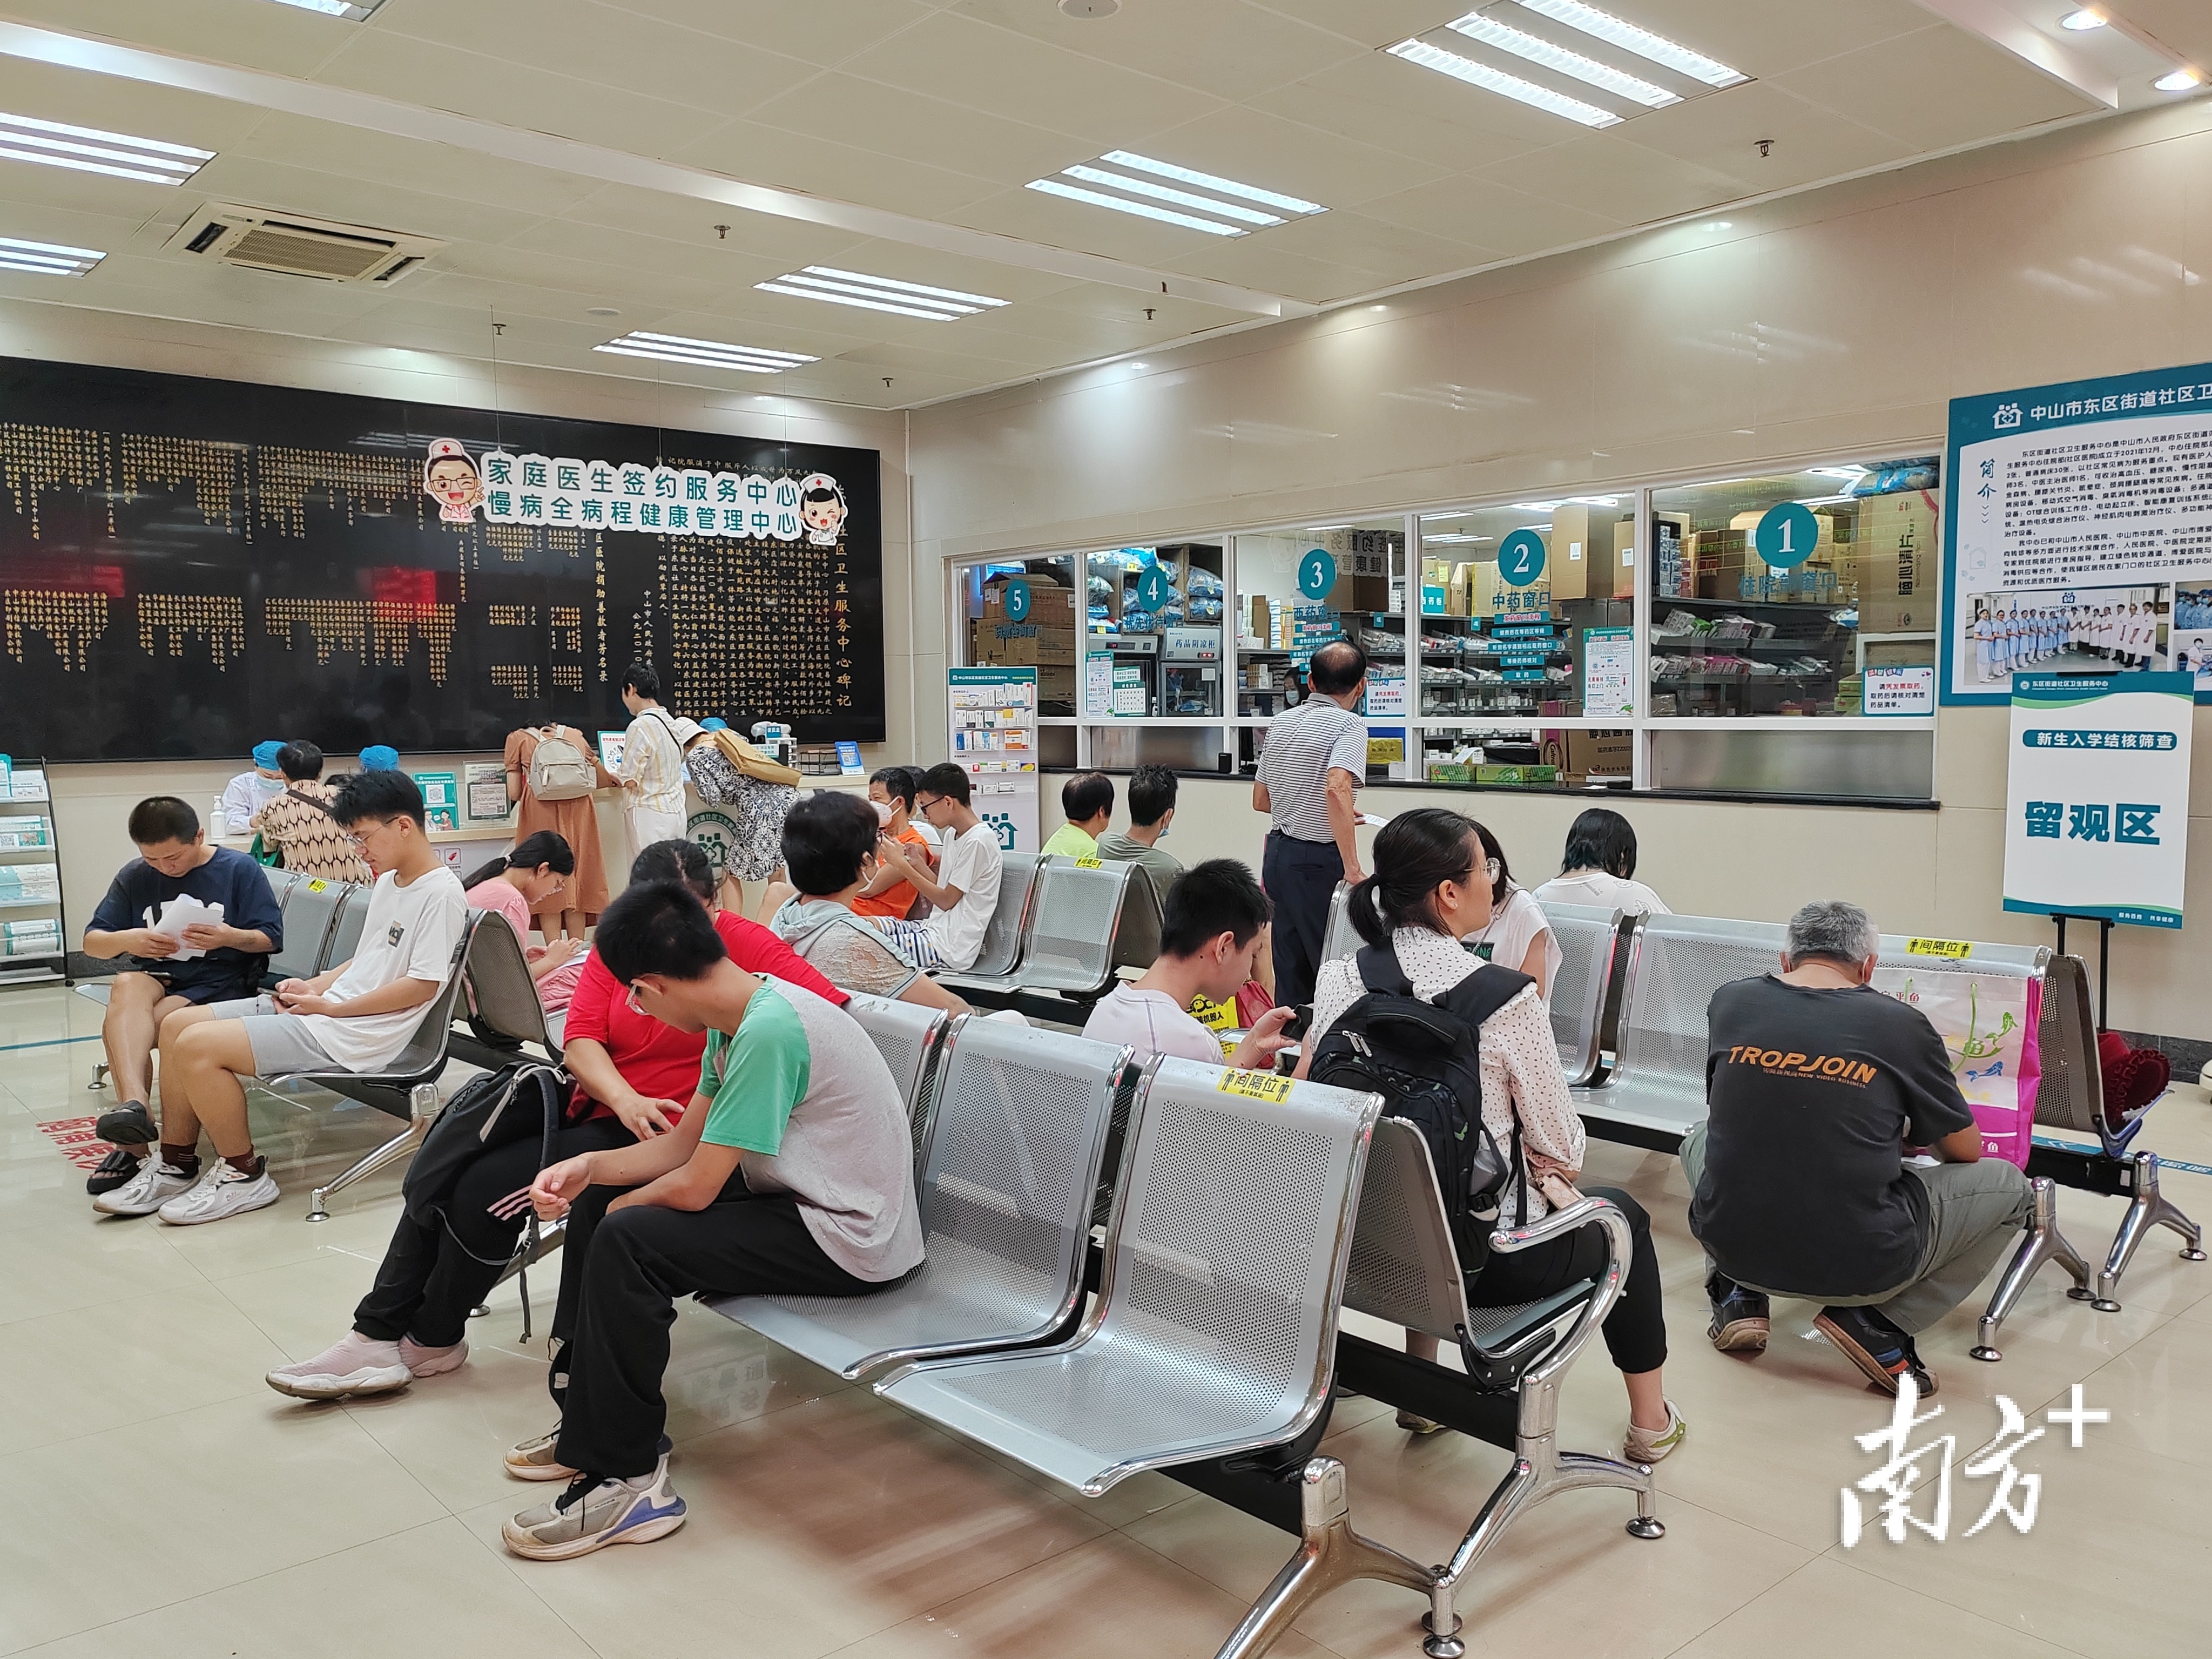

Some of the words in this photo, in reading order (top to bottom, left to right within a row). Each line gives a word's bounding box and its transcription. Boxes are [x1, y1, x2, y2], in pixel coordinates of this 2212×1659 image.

[2031, 383, 2212, 421] 中山市东区街道社区卫
[487, 458, 797, 507] 家庭医生签约服务中心
[1978, 458, 1997, 501] 简介
[488, 489, 798, 534] 慢病全病程健康管理中心
[1777, 519, 1795, 552] 1
[1513, 544, 1529, 573] 2
[1898, 534, 1914, 595] 脑心清片
[1148, 577, 1158, 601] 4
[1310, 562, 1323, 588] 3
[1013, 590, 1022, 611] 5
[1493, 591, 1550, 610] 中药窗口
[1175, 639, 1216, 649] 药品阴凉柜
[2037, 732, 2173, 749] 新生入学结核筛查
[2025, 801, 2161, 846] 留观区
[1919, 940, 1958, 952] 间隔位
[1728, 1046, 1877, 1084] TROPJOIN
[1234, 1073, 1279, 1093] 间隔位
